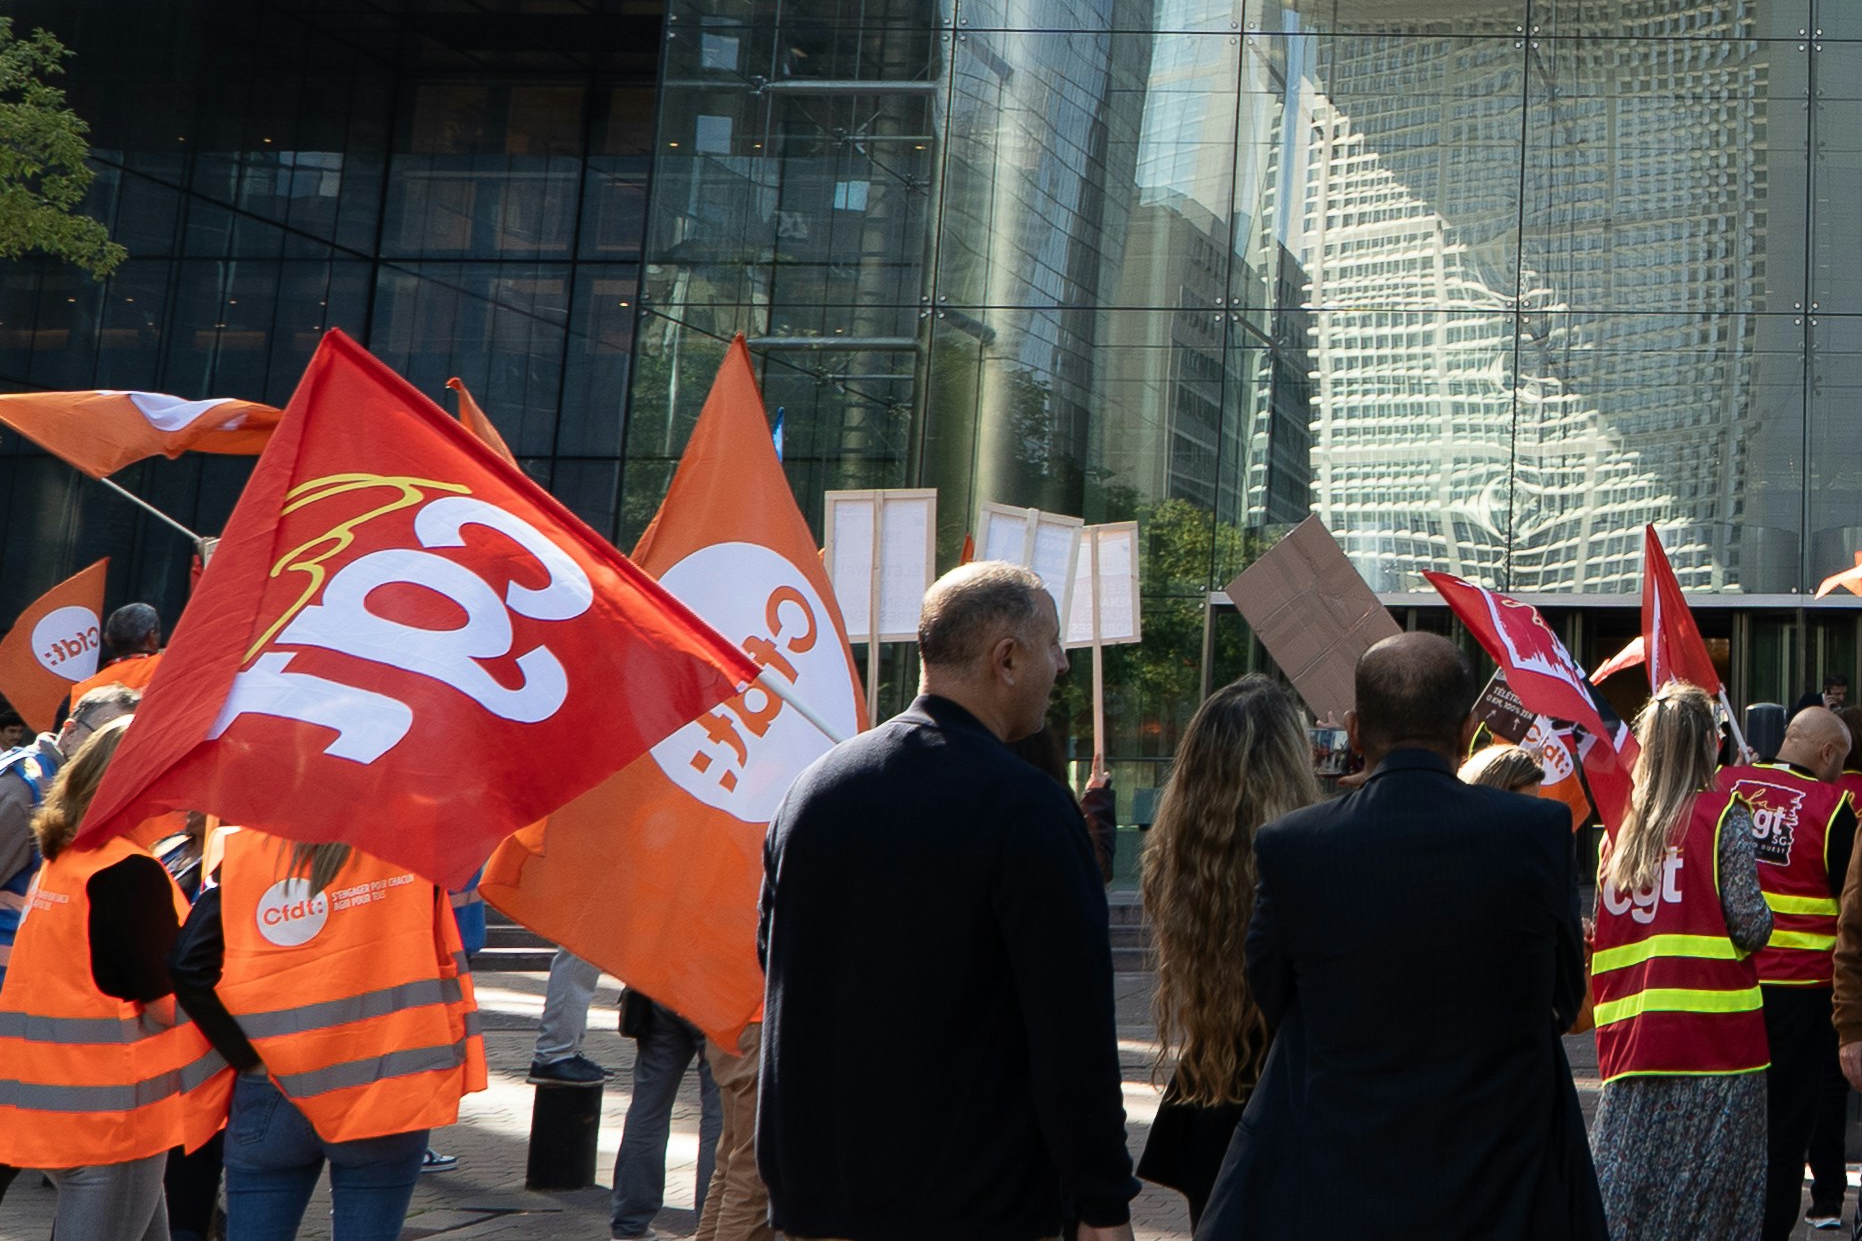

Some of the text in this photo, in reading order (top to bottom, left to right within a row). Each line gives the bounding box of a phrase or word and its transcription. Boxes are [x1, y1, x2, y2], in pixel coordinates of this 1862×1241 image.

[1525, 724, 1570, 774] Cdt:
[1751, 807, 1786, 838] gt
[263, 898, 324, 926] Cfdt:
